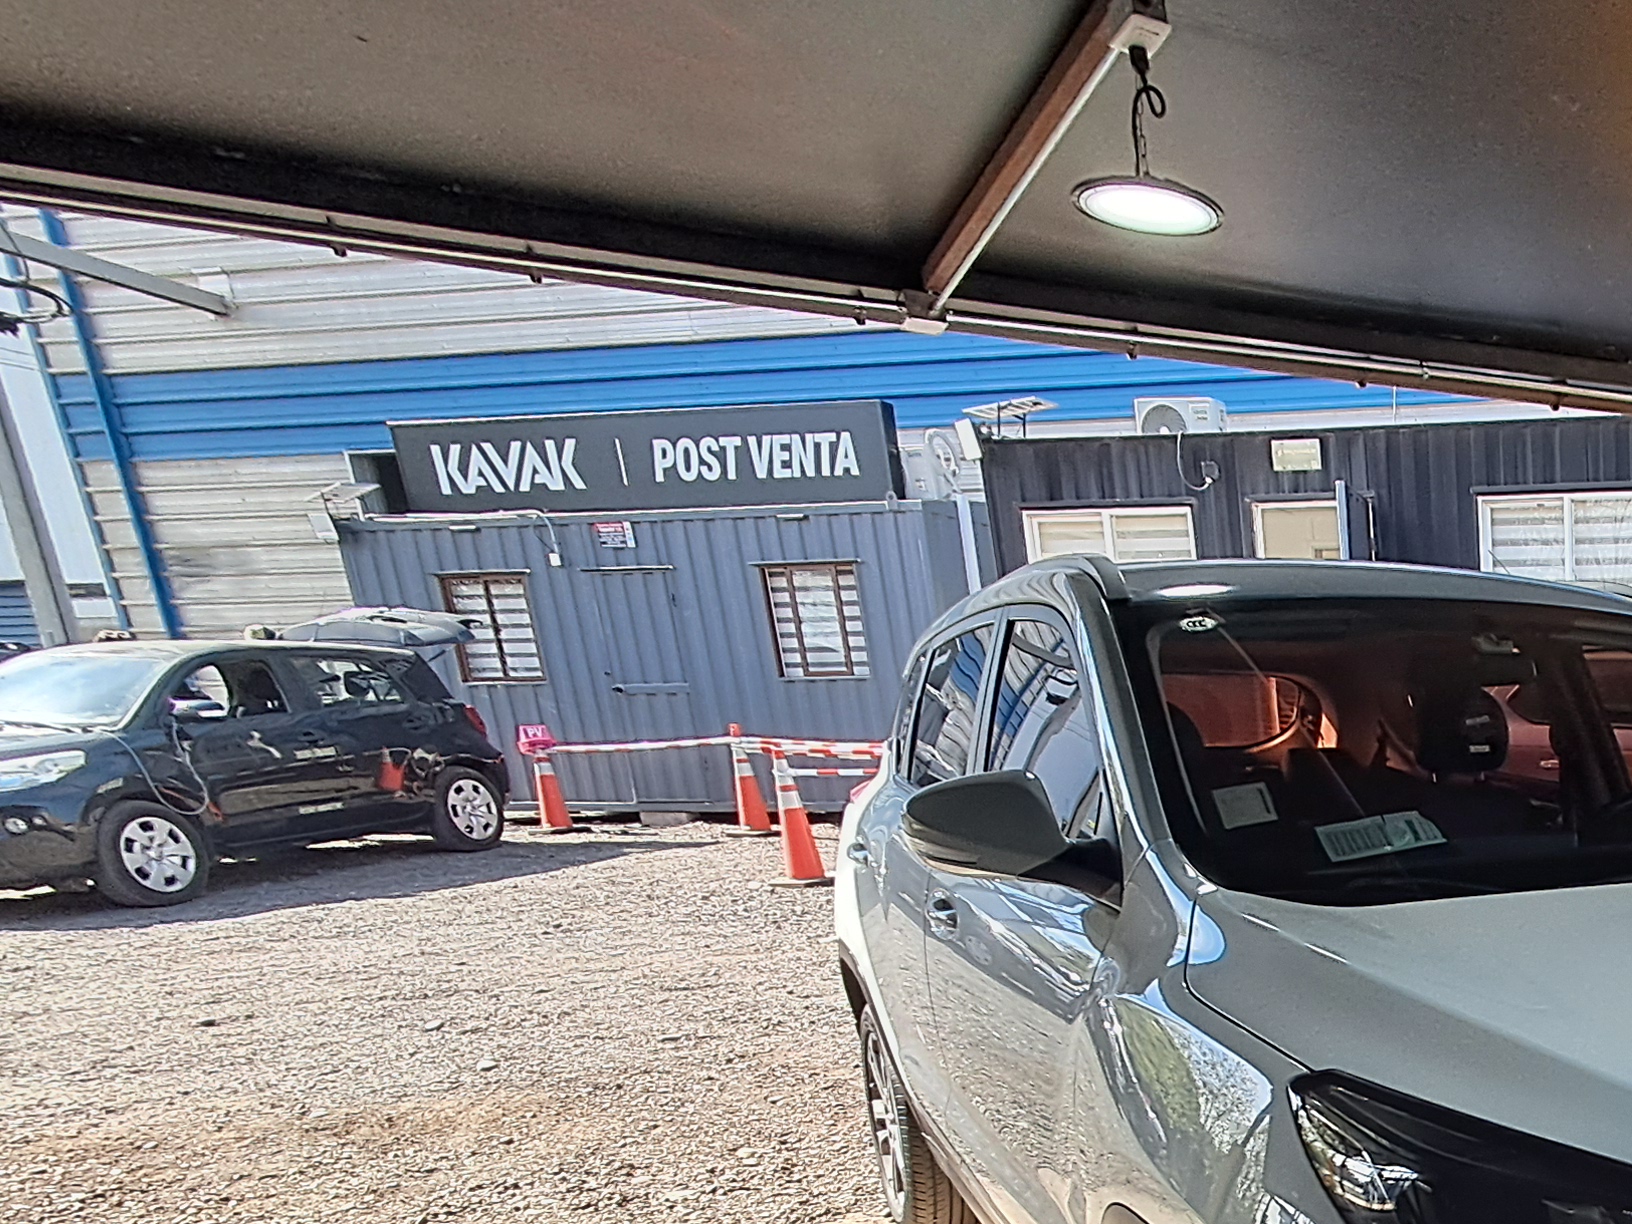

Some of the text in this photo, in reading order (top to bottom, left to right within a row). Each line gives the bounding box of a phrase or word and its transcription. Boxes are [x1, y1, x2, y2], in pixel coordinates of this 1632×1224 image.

[429, 431, 860, 495] KAVAK POST VENTA
[526, 727, 543, 738] PV
